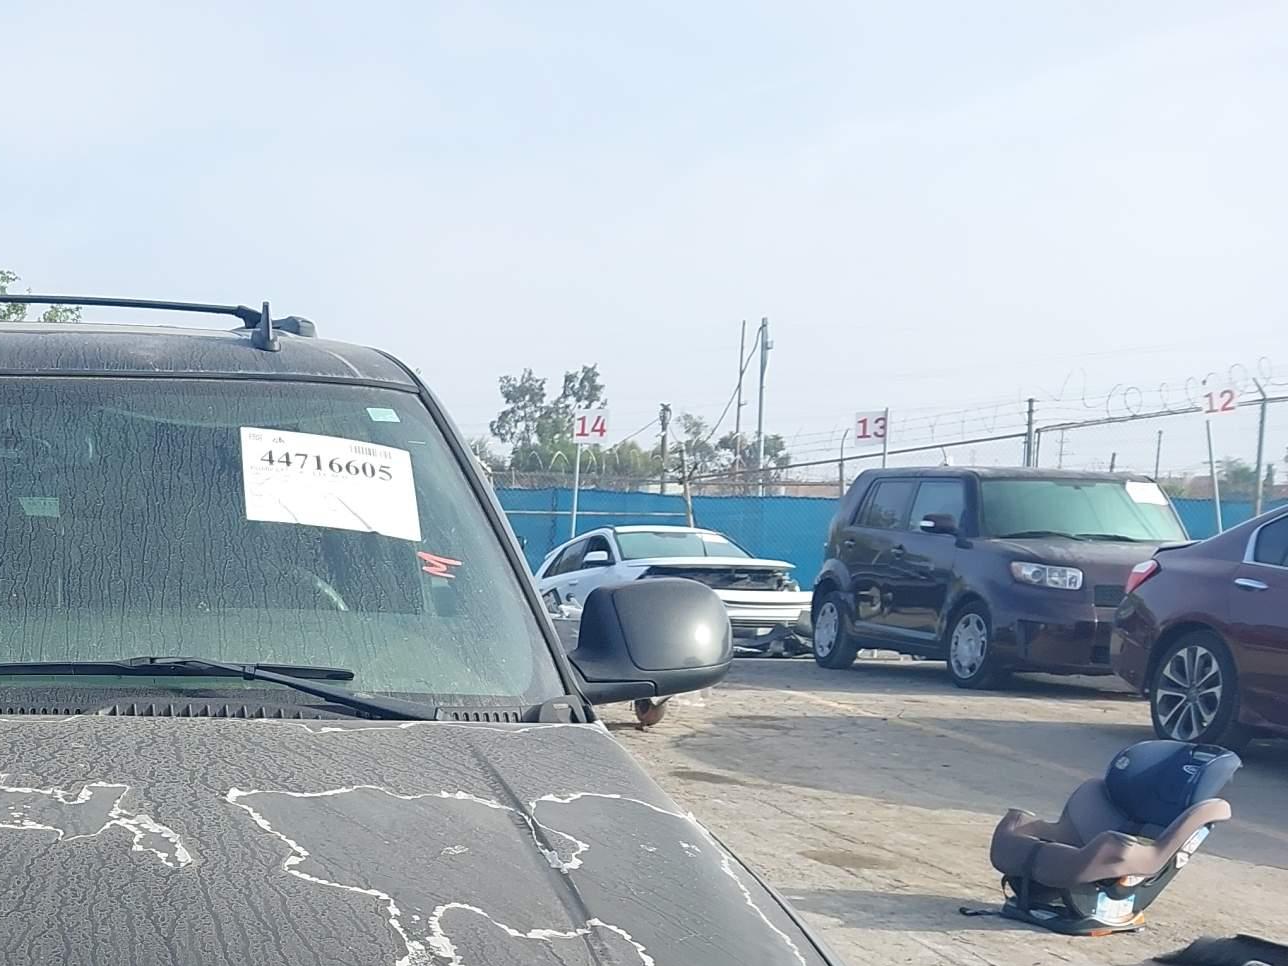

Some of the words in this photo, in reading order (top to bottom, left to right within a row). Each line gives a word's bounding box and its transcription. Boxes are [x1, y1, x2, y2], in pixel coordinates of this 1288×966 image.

[1203, 389, 1236, 414] 12
[575, 415, 606, 437] 14
[857, 416, 887, 439] 13
[260, 449, 393, 482] 44716605
